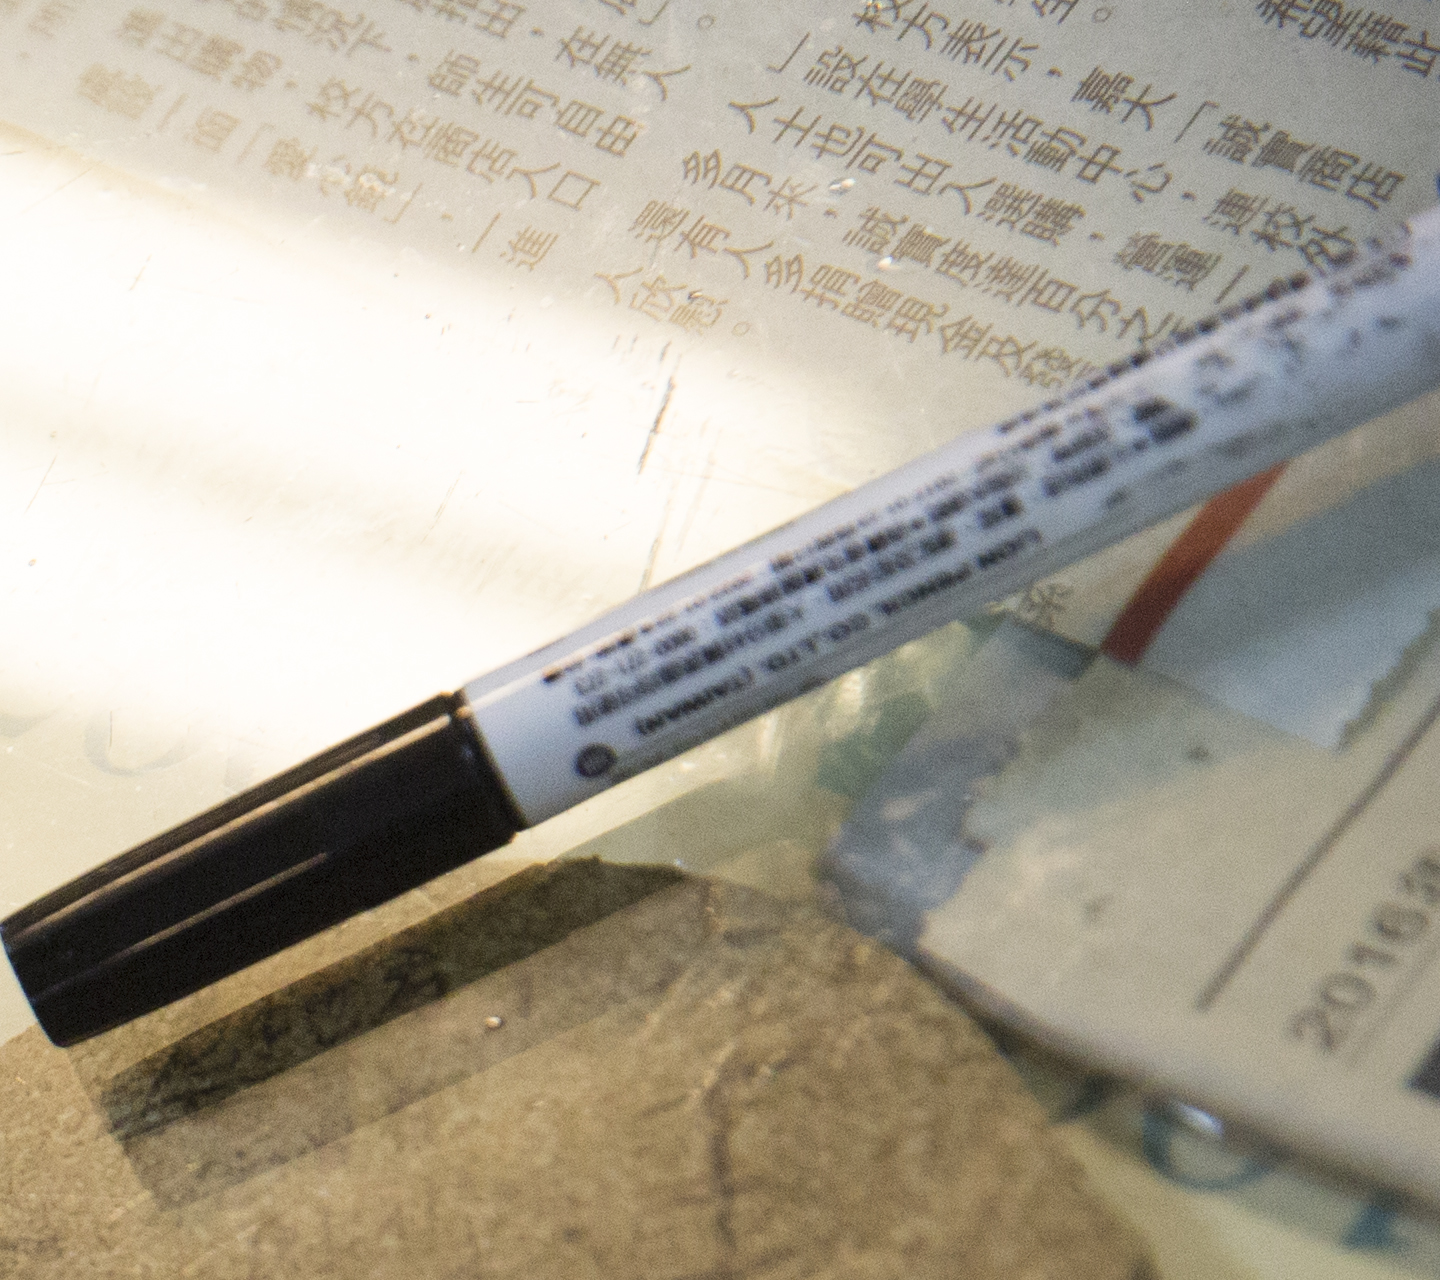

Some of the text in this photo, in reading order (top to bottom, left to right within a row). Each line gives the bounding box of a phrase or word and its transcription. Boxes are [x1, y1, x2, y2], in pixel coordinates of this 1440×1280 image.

[628, 199, 1092, 388] 還有人多捐贈現金及發
[681, 148, 1183, 348] 多月來，誠實度達百分之
